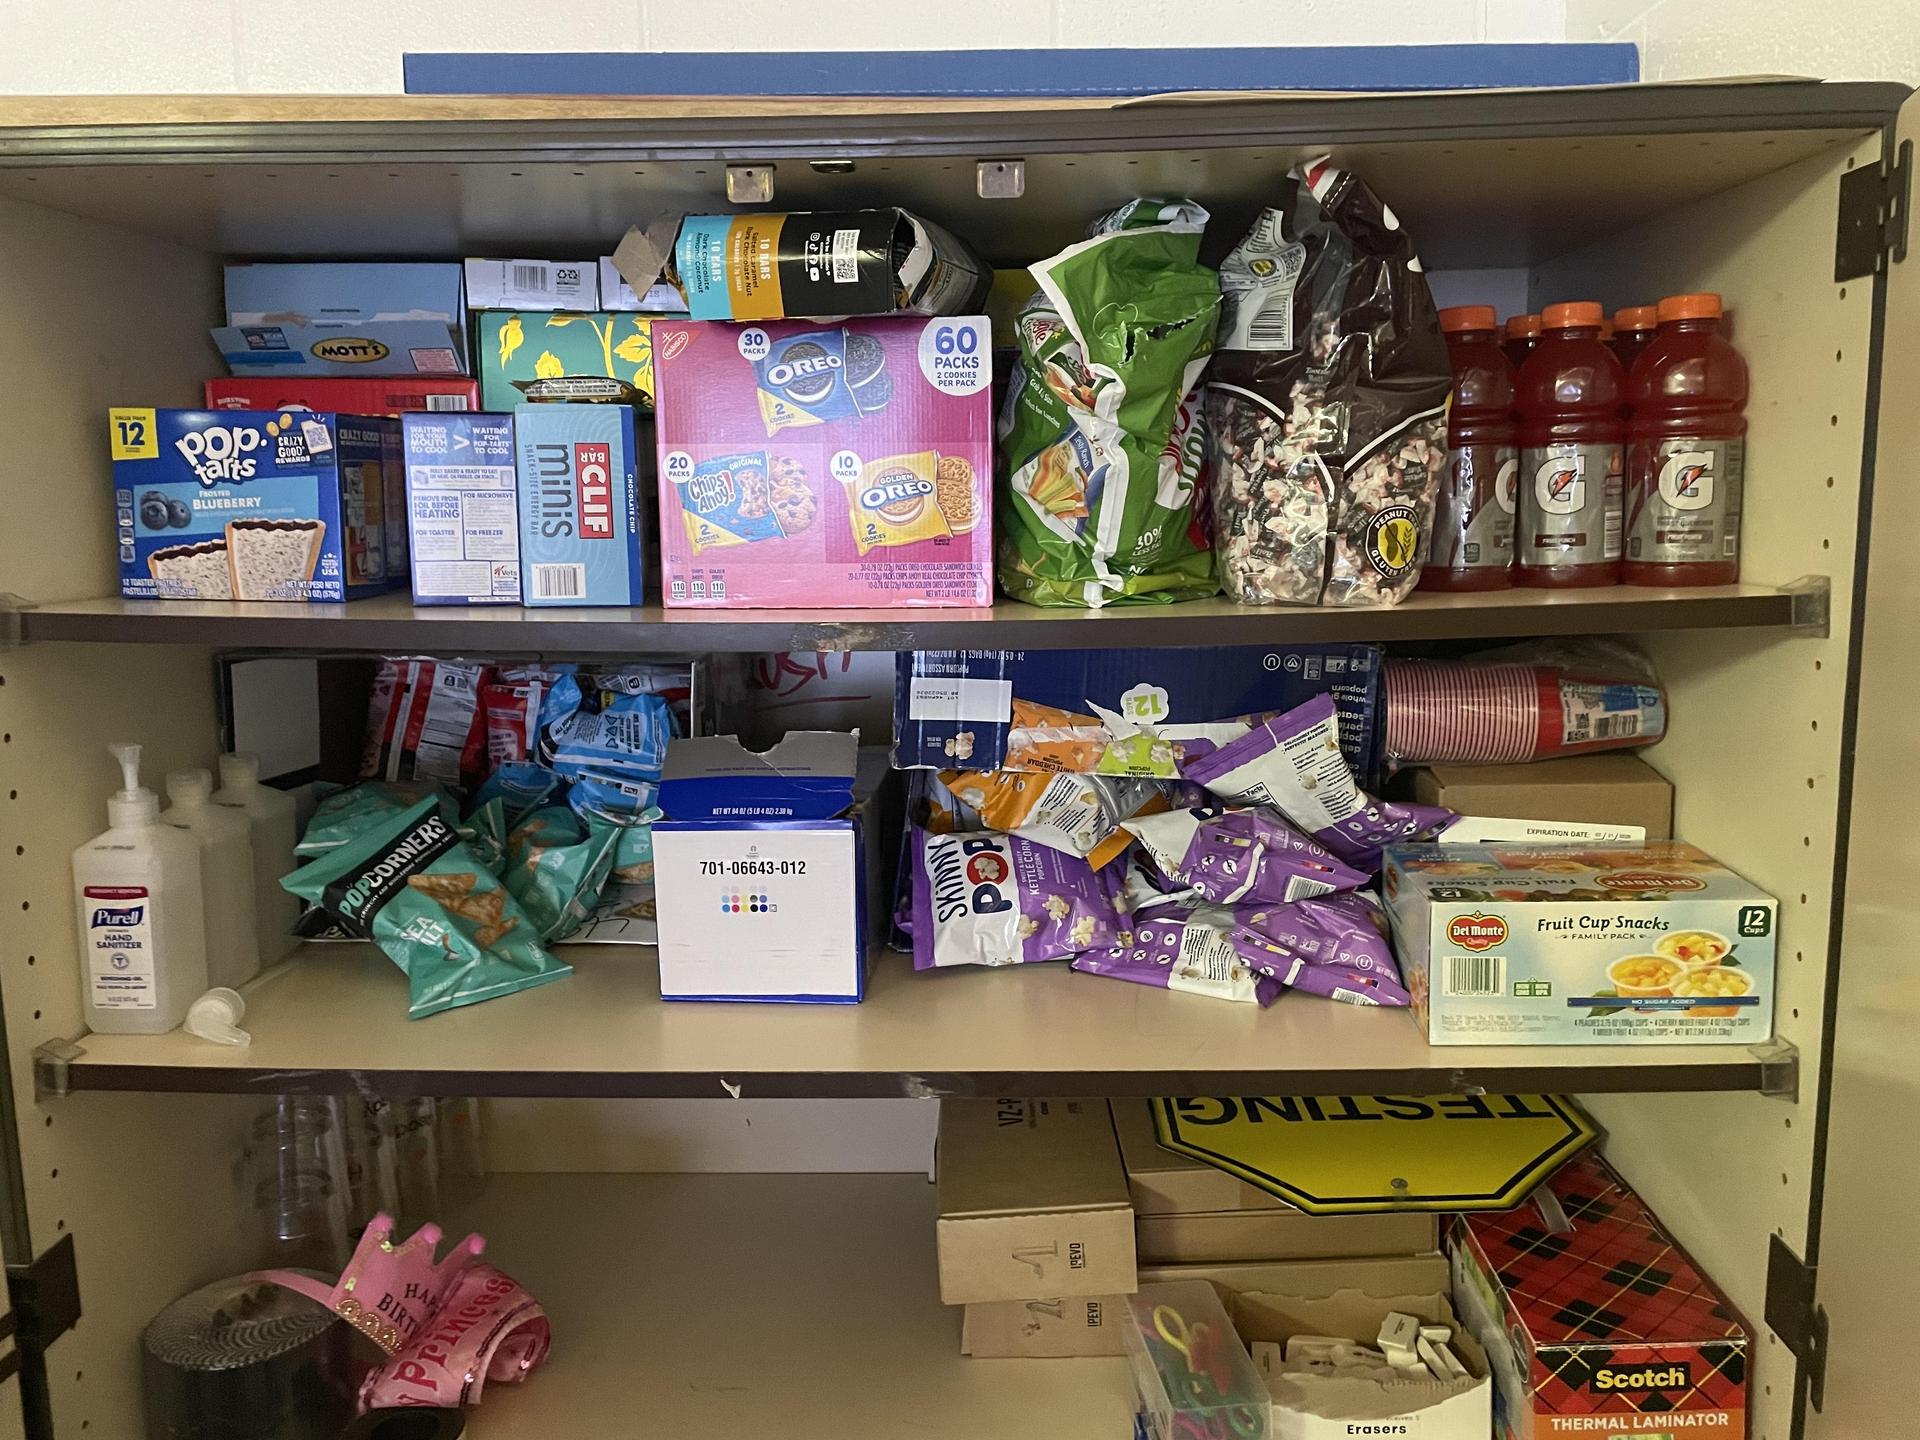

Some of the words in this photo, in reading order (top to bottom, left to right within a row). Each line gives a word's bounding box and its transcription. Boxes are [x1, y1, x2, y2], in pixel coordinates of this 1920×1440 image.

[702, 233, 710, 250] Dark
[702, 252, 710, 291] Chocolate
[760, 254, 771, 280] BARS
[695, 261, 704, 294] Coconut
[745, 282, 753, 297] Nut
[744, 333, 764, 347] 30
[934, 326, 979, 356] 60
[321, 342, 381, 357] MOTT'S
[743, 347, 766, 355] PACKS
[934, 356, 980, 370] PACKS
[768, 354, 842, 386] OREO
[936, 371, 943, 380] 2
[945, 371, 977, 380] COOKIES
[938, 379, 954, 388] PER
[956, 379, 977, 388] PACK
[774, 403, 786, 416] 2
[117, 421, 146, 447] 12
[410, 426, 447, 434] WAITING
[472, 427, 508, 435] WAITING
[278, 436, 304, 447] CRAZY
[410, 439, 447, 447] MOUTH
[278, 446, 303, 458] GOOD
[411, 446, 423, 454] TO
[425, 446, 448, 454] COOL
[275, 456, 311, 464] REWARDS
[580, 451, 606, 463] BAR
[669, 456, 688, 469] 20
[839, 455, 854, 469] 10
[1080, 446, 1090, 469] Ranch
[728, 458, 763, 471] ORIGINAL
[668, 470, 690, 478] PACKS
[879, 472, 914, 485] GOLDEN
[1658, 449, 1715, 512] G
[536, 444, 573, 538] minis
[688, 473, 725, 501] Chips
[1535, 454, 1587, 515] G
[581, 464, 609, 533] CLIF
[861, 479, 934, 510] OREO
[193, 497, 261, 510] BLUEBERRY
[414, 509, 460, 518] HEATING
[1374, 509, 1408, 529] PEANUT
[700, 523, 711, 535] 2
[866, 523, 877, 535] 2
[1371, 549, 1399, 577] GLUTEN
[321, 567, 340, 577] USA
[673, 583, 685, 591] 110
[693, 583, 705, 591] 110
[712, 583, 724, 591] 110
[1331, 684, 1368, 694] popcorn
[1133, 693, 1163, 717] 12
[1341, 693, 1367, 704] whole
[1027, 758, 1055, 770] CHEDDAR
[1246, 785, 1264, 798] Facts
[712, 807, 723, 815] NET
[1526, 828, 1569, 838] EXPIRATION
[1570, 830, 1591, 838] DATE:
[1020, 839, 1034, 863] CORN
[338, 815, 447, 920] POPCORNERS
[700, 860, 806, 875] 701-06643-012
[928, 839, 968, 923] SKINNY
[1024, 863, 1040, 896] KETTLE
[96, 909, 140, 925] Purell
[1537, 917, 1574, 932] Fruit
[1579, 915, 1611, 932] Cup
[1616, 915, 1670, 932] Snacks
[1744, 909, 1766, 927] 12
[400, 916, 434, 942] SEA
[1453, 925, 1470, 936] Del
[1471, 926, 1504, 936] Monte
[1743, 926, 1765, 936] Cups
[104, 933, 133, 942] HAND
[1571, 933, 1608, 941] FAMILY
[1610, 933, 1636, 941] PACK
[96, 941, 143, 950] SANITIZER
[1176, 1095, 1559, 1126] TESTING
[1069, 1242, 1083, 1270] IPEVO
[1087, 1302, 1099, 1328] IPEVO
[1596, 1367, 1686, 1390] Scotch
[1551, 1416, 1629, 1431] THERMAL
[1633, 1412, 1730, 1430] LAMINATOR
[1347, 1423, 1408, 1435] Erasers
